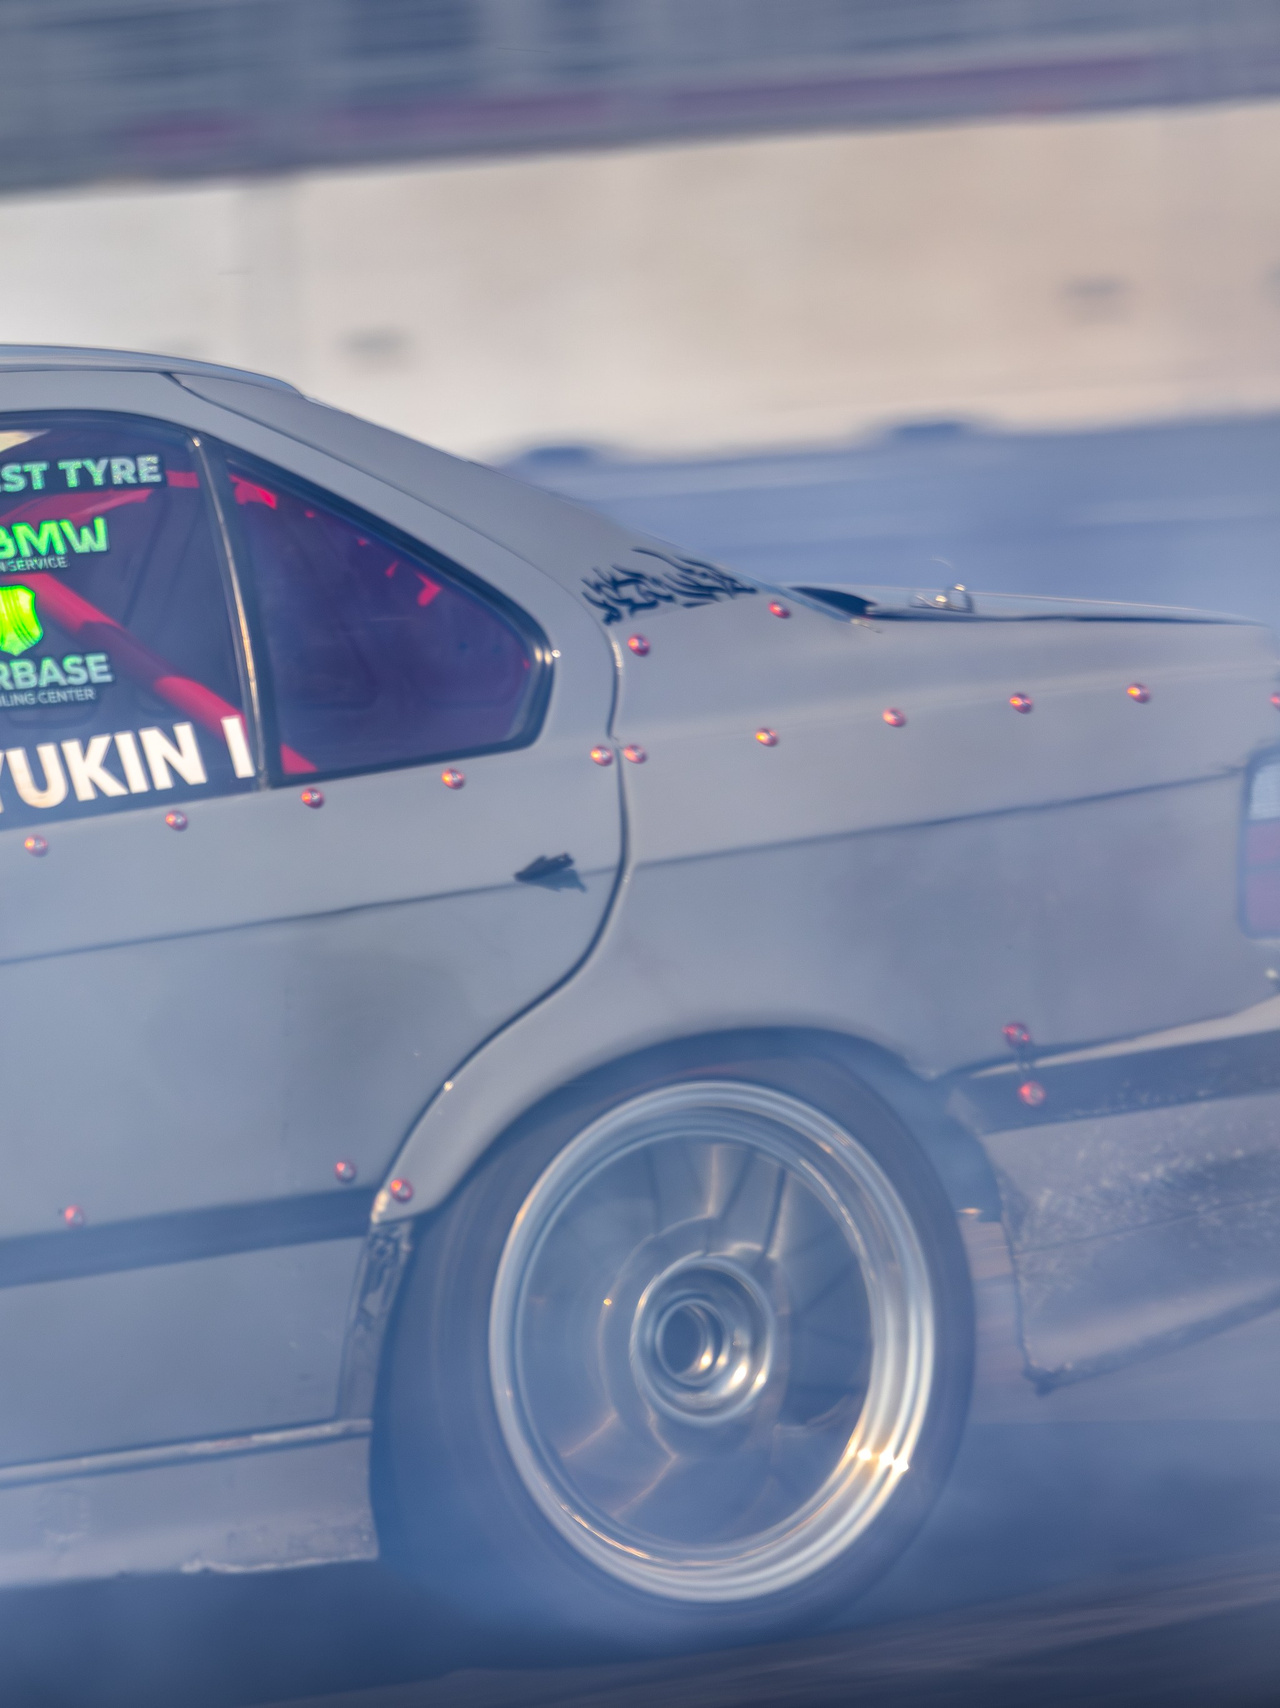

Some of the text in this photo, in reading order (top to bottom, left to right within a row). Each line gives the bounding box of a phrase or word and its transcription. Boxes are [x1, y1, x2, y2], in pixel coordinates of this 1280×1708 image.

[58, 455, 161, 487] TYRE
[8, 556, 68, 571] SERVICE
[37, 687, 95, 704] CENTER
[220, 714, 256, 779] I
